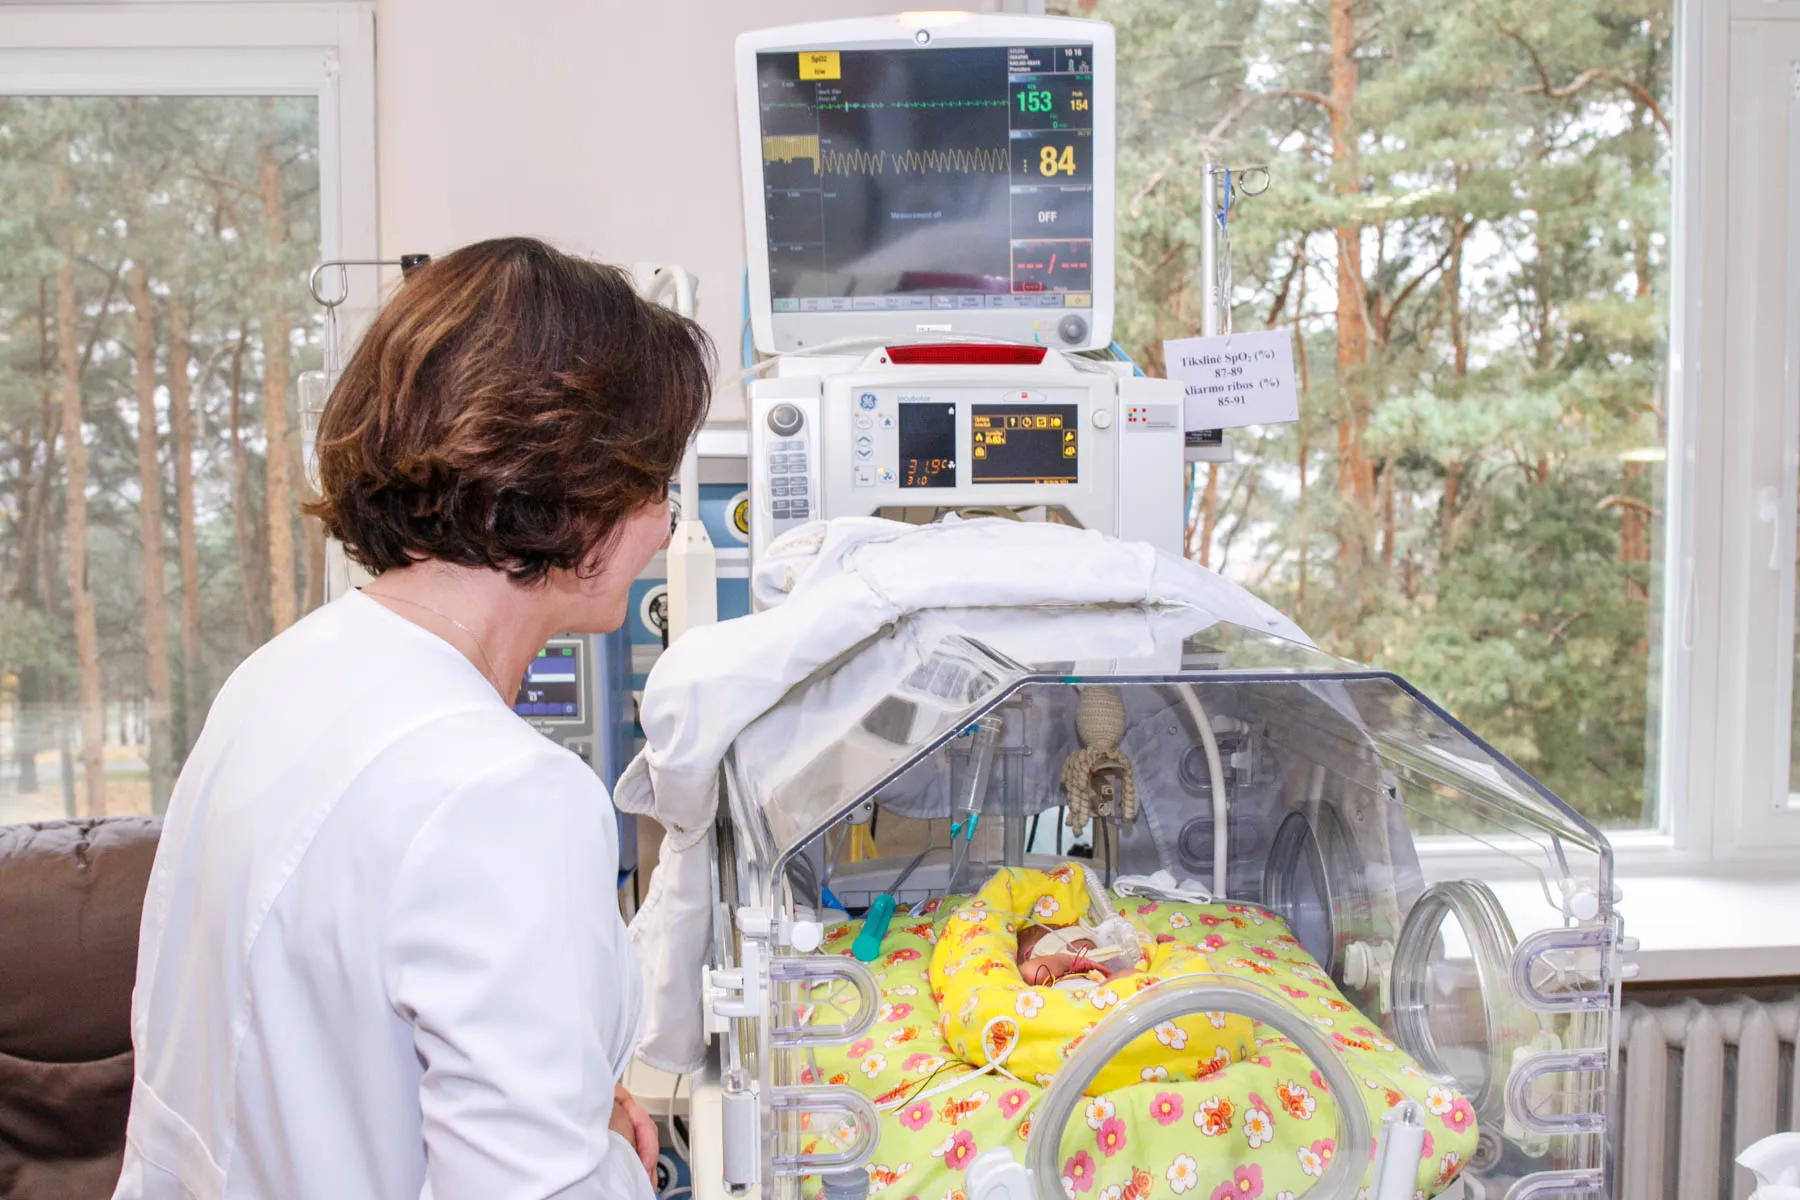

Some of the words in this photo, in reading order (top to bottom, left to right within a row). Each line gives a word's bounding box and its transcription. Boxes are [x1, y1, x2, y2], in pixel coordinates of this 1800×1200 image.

[1016, 91, 1053, 112] 153
[1070, 99, 1089, 111] 154
[1039, 145, 1077, 177] 84
[1038, 211, 1057, 223] OFF
[1214, 367, 1243, 378] 87-89
[1227, 381, 1254, 391] ribos
[1217, 395, 1246, 407] 85-91
